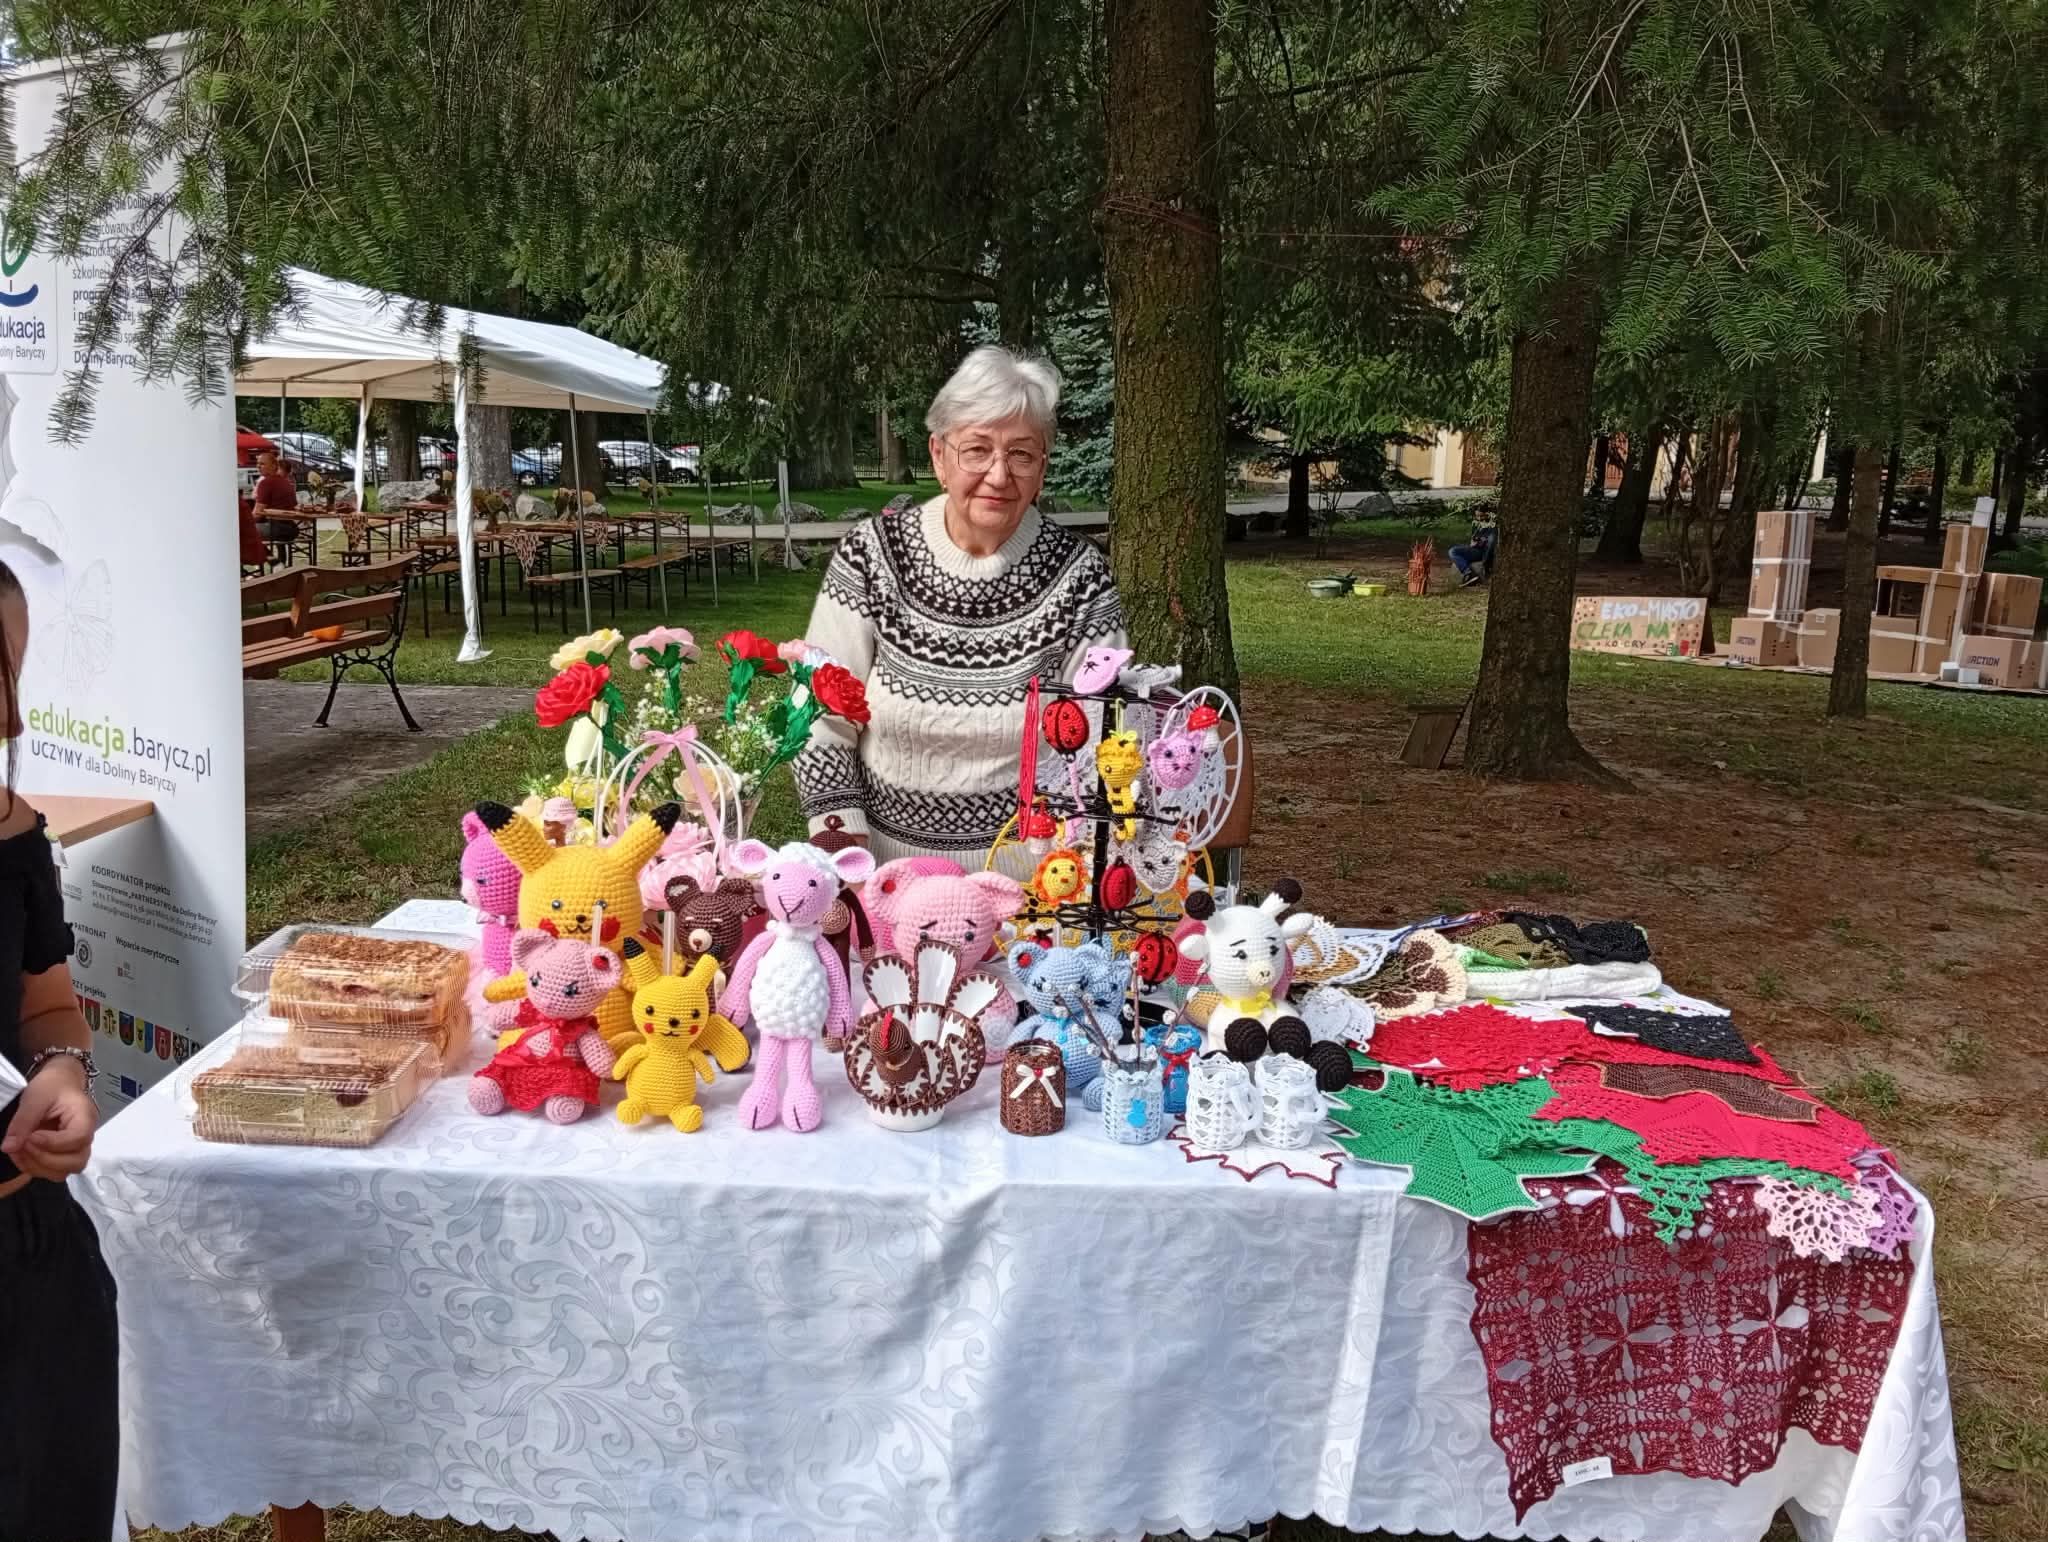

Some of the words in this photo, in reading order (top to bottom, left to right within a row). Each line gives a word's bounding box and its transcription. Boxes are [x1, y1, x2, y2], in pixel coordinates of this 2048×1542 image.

[0, 315, 45, 344] ukacja
[16, 346, 45, 360] Baryczy
[1576, 622, 1632, 640] CZEKA
[29, 702, 211, 782] edukacja.barycz.pl
[31, 739, 82, 768] UCZYMY
[85, 756, 100, 773] dla
[103, 760, 136, 785] Doliny
[139, 769, 176, 797] Baryczy
[91, 864, 144, 888] KOORDYNATOR
[145, 882, 171, 897] projektu
[75, 922, 106, 939] PATRONAT
[116, 936, 140, 952] Wsparcie
